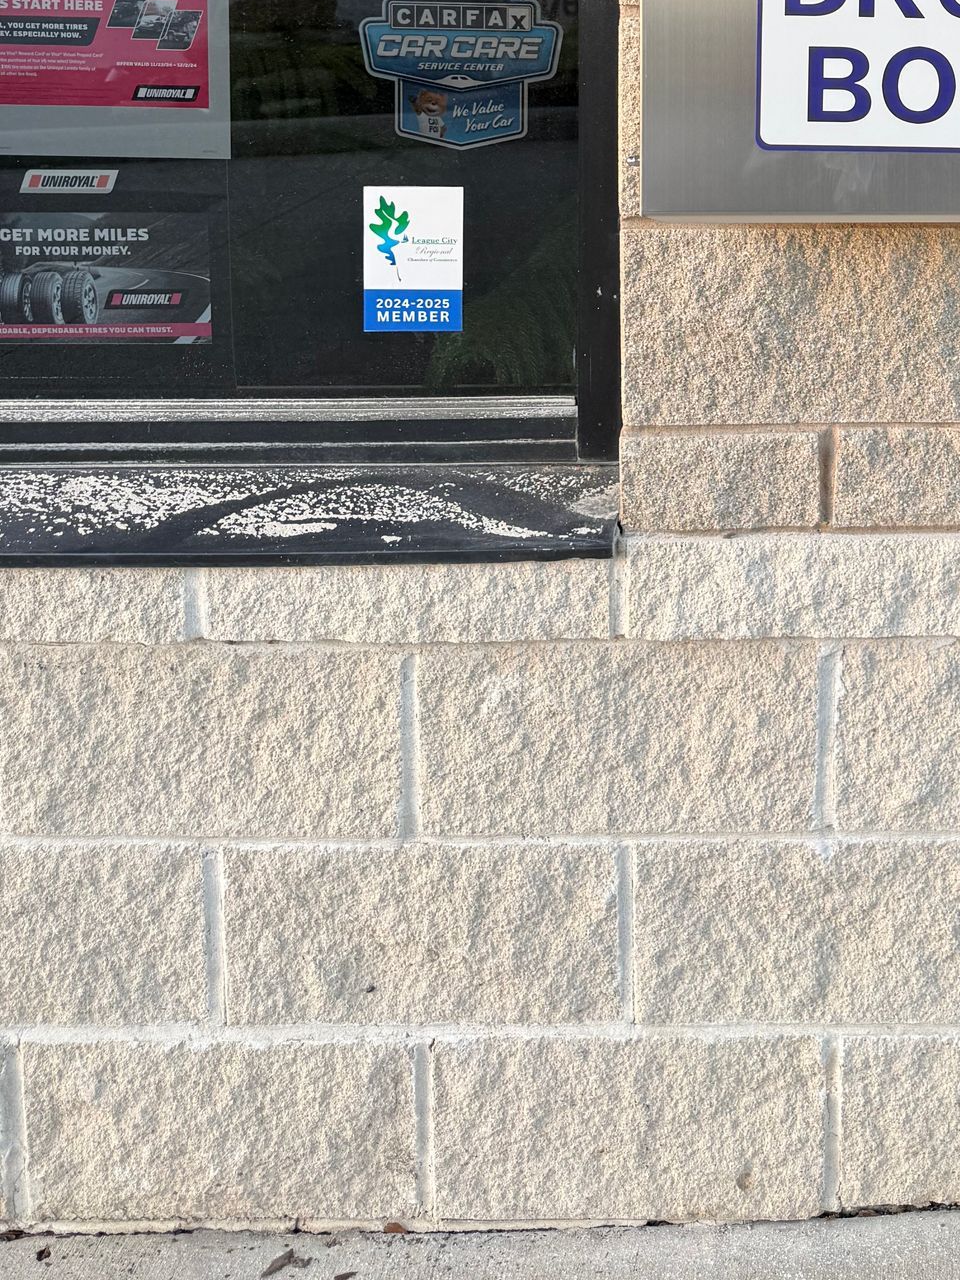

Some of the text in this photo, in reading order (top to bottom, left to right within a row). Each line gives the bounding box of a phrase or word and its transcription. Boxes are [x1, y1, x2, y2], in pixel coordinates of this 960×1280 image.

[64, 0, 104, 12] HERE
[396, 8, 529, 30] CARFAX
[7, 22, 24, 30] YOU
[25, 22, 41, 30] GET
[41, 23, 64, 31] MORE
[60, 31, 82, 39] NOW.
[376, 35, 545, 60] CAR CARE
[417, 62, 505, 71] SERVICE CENTER
[145, 88, 186, 98] UNIROYAL
[452, 98, 505, 119] We Value
[464, 113, 515, 134] Your Car
[41, 175, 98, 188] UNIROYAL
[0, 228, 149, 242] GET MORE MILES
[411, 236, 458, 246] League City
[15, 246, 131, 256] FOR YOUR MONEY.
[415, 245, 454, 258] Regional
[122, 293, 172, 305] UNIROYAL
[376, 298, 450, 309] 2024-2025
[376, 310, 450, 323] MEMBER
[31, 327, 83, 335] DEPENDABLE
